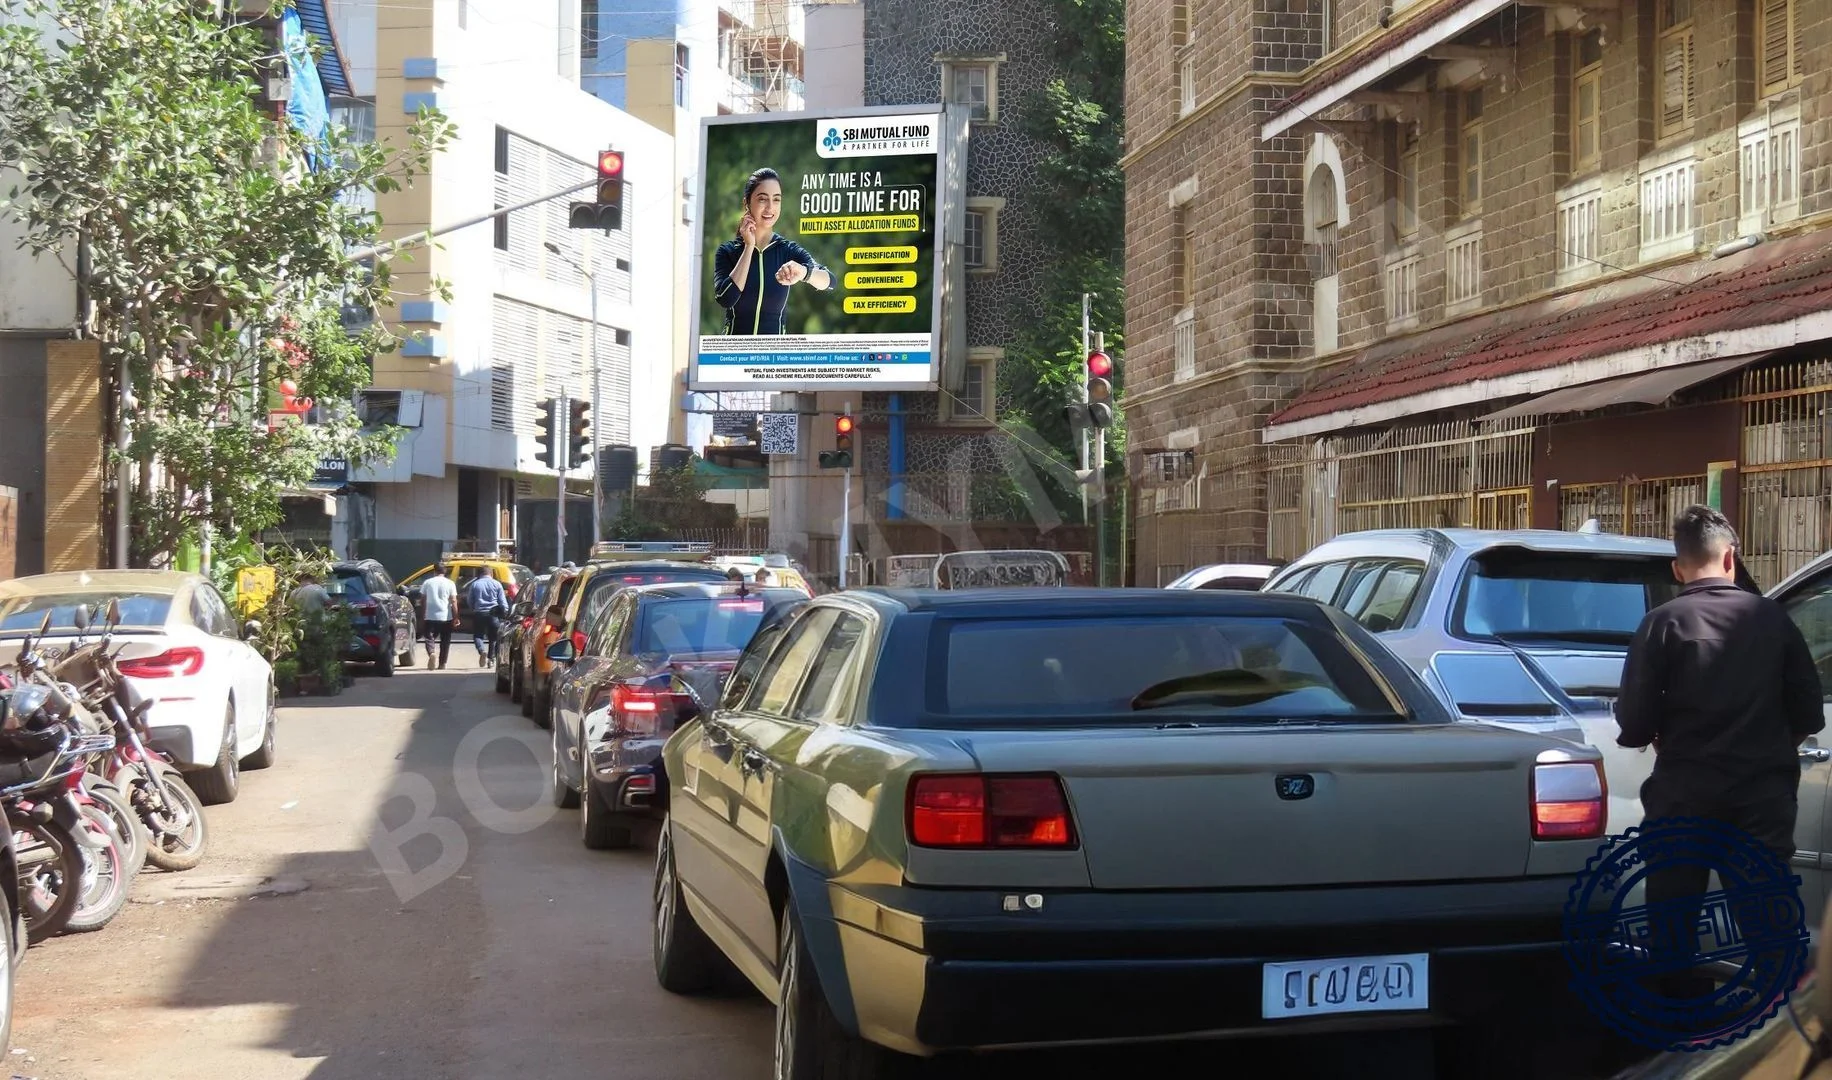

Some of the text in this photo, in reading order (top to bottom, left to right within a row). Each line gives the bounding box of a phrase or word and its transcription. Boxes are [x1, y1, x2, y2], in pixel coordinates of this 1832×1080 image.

[843, 125, 930, 140] SBI MUTUAL FUND
[851, 142, 887, 150] PARTNER
[892, 141, 907, 149] FOR
[911, 140, 930, 148] LIFE
[801, 171, 882, 190] ANY TIME IS A
[800, 189, 921, 214] GOOD TIME FOR
[801, 218, 916, 232] MULTI ASSET ALLOCATION FUNDS
[853, 251, 910, 260] DIVERSIFICATION
[857, 276, 904, 284] CONVENIENCE
[853, 300, 907, 309] TAX EFFICIENCY
[314, 461, 345, 470] ALON
